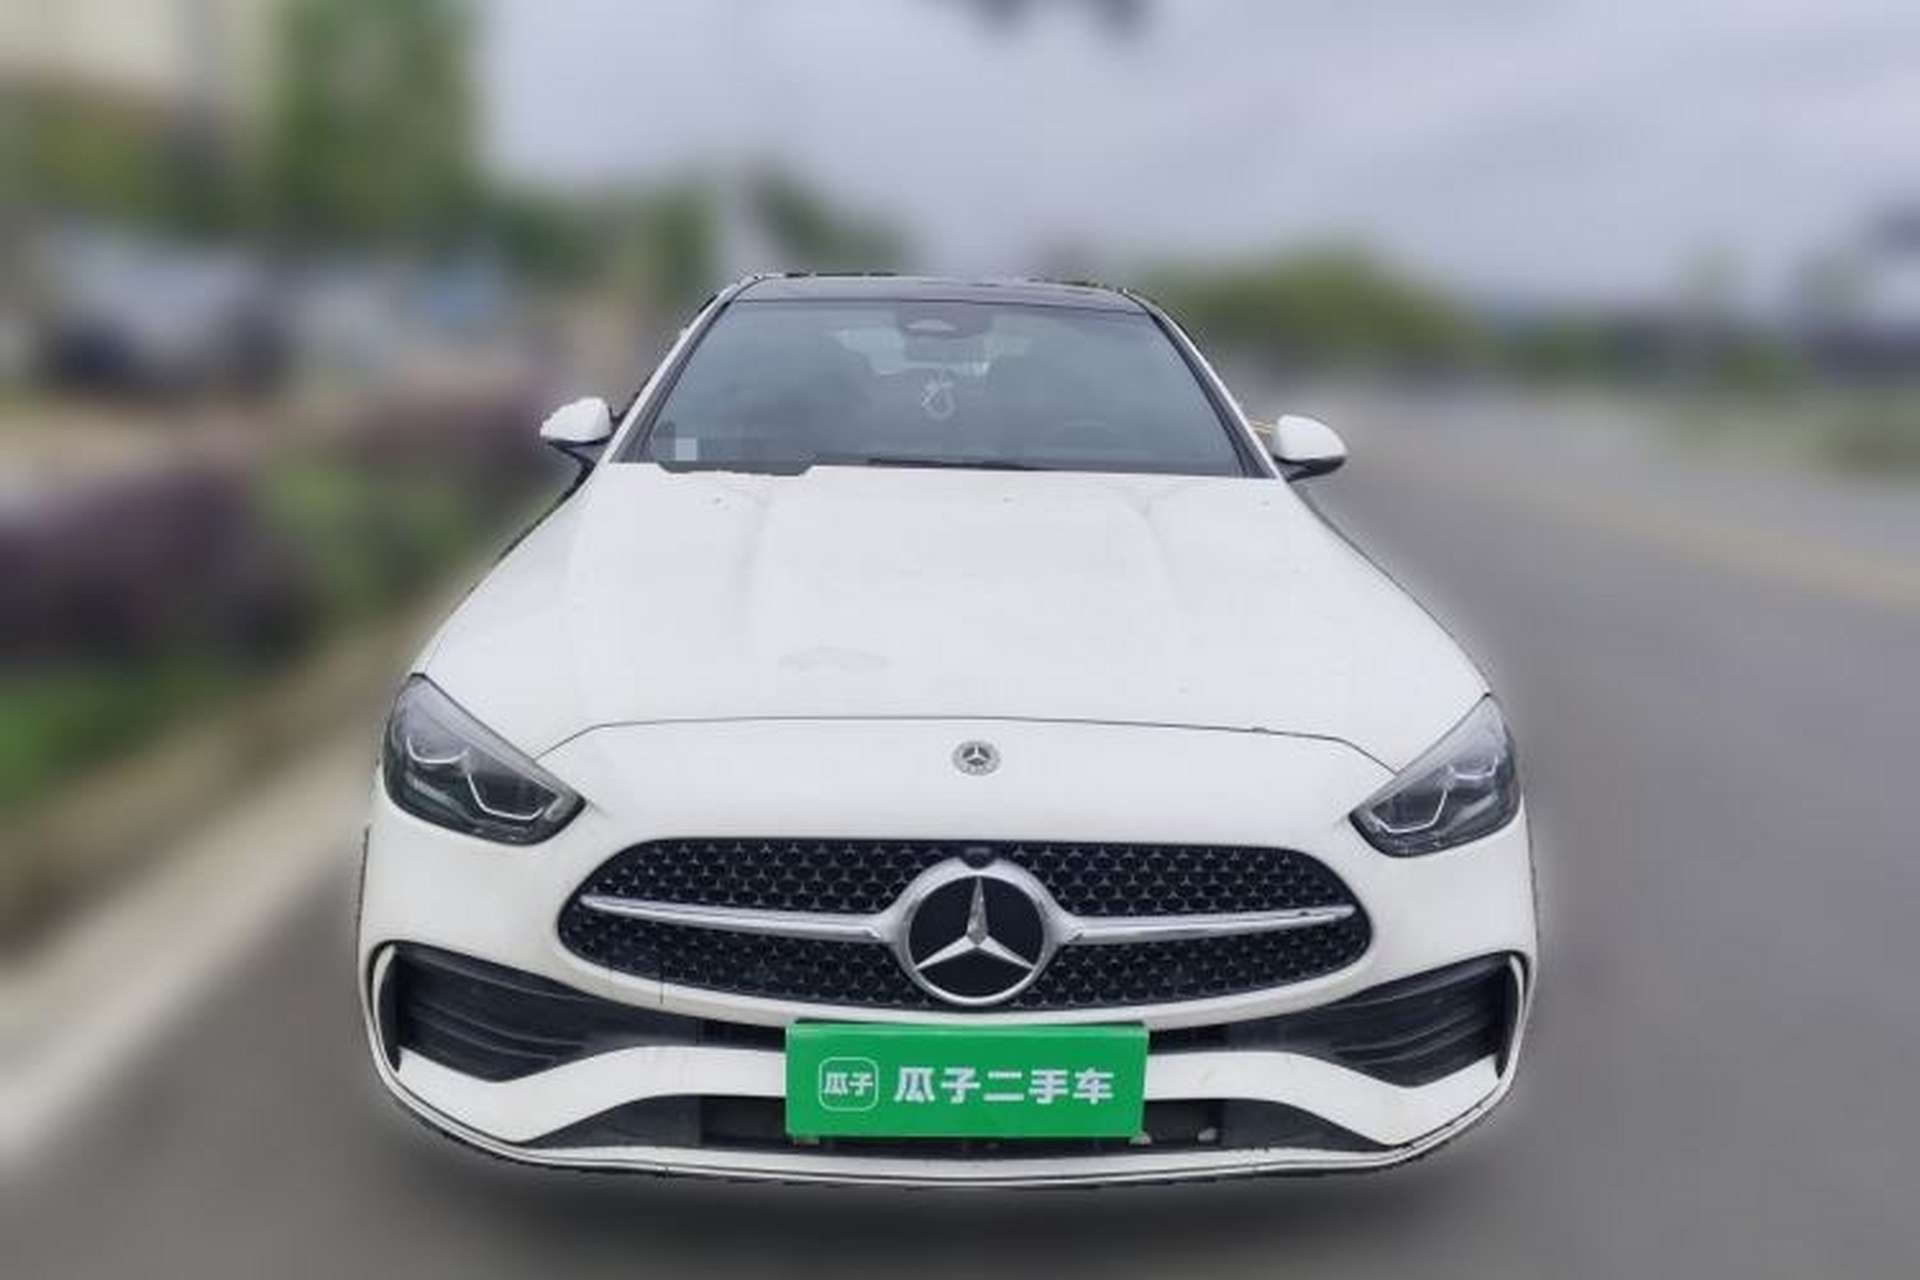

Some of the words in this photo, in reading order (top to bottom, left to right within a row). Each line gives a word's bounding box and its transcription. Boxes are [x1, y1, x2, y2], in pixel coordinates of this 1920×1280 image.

[823, 1071, 874, 1096] 瓜子
[894, 1067, 1115, 1104] 瓜子二手车
